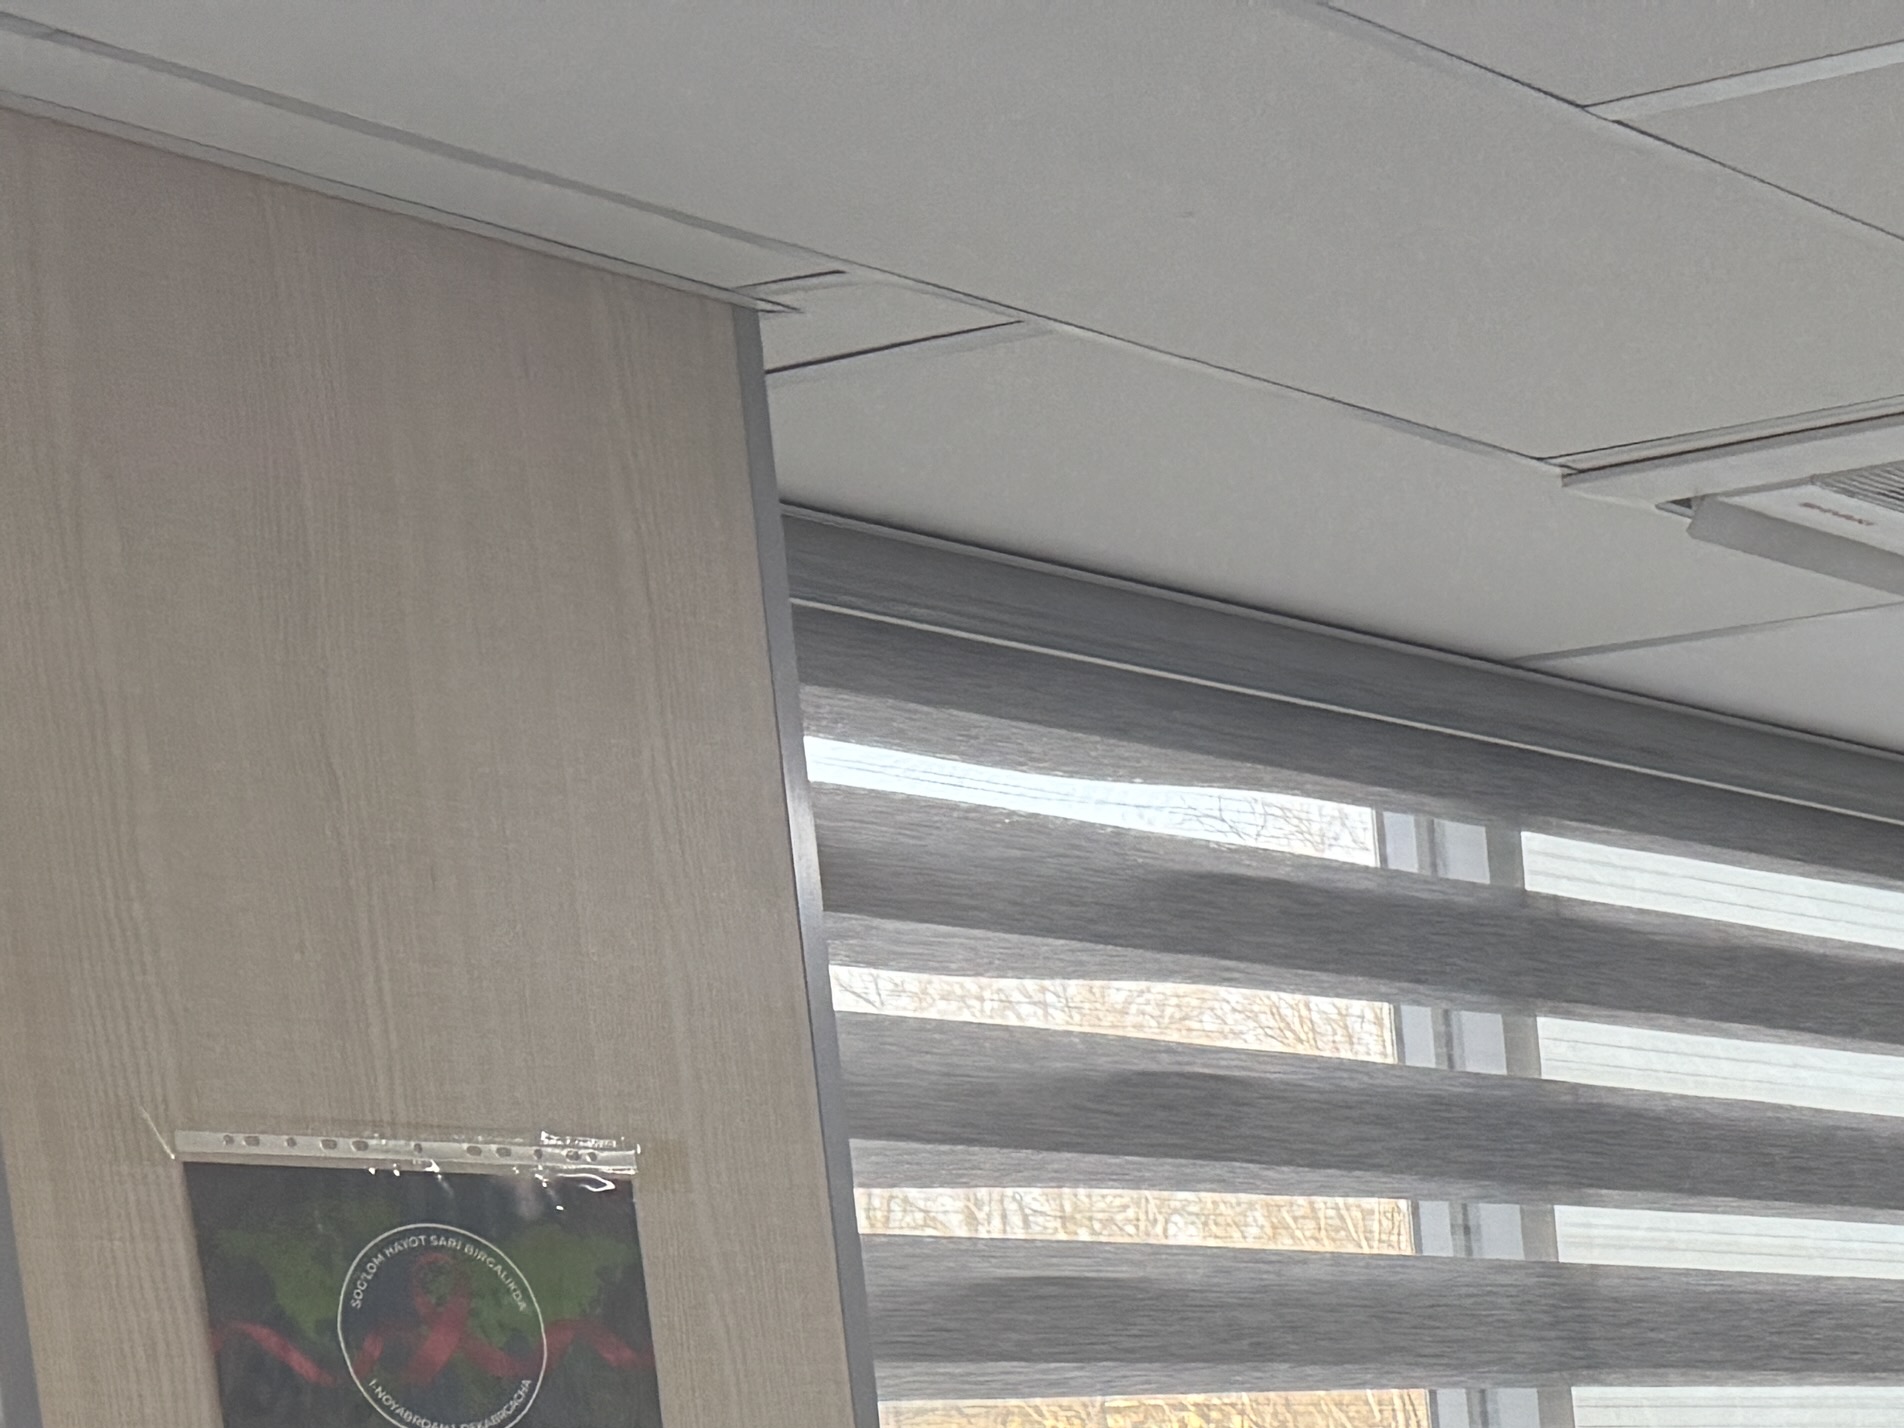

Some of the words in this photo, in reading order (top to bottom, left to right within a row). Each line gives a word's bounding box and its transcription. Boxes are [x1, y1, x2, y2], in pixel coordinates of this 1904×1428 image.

[385, 1235, 427, 1258] HAYOT
[430, 1234, 461, 1250] SARI
[464, 1243, 527, 1312] BIRGALIKDA
